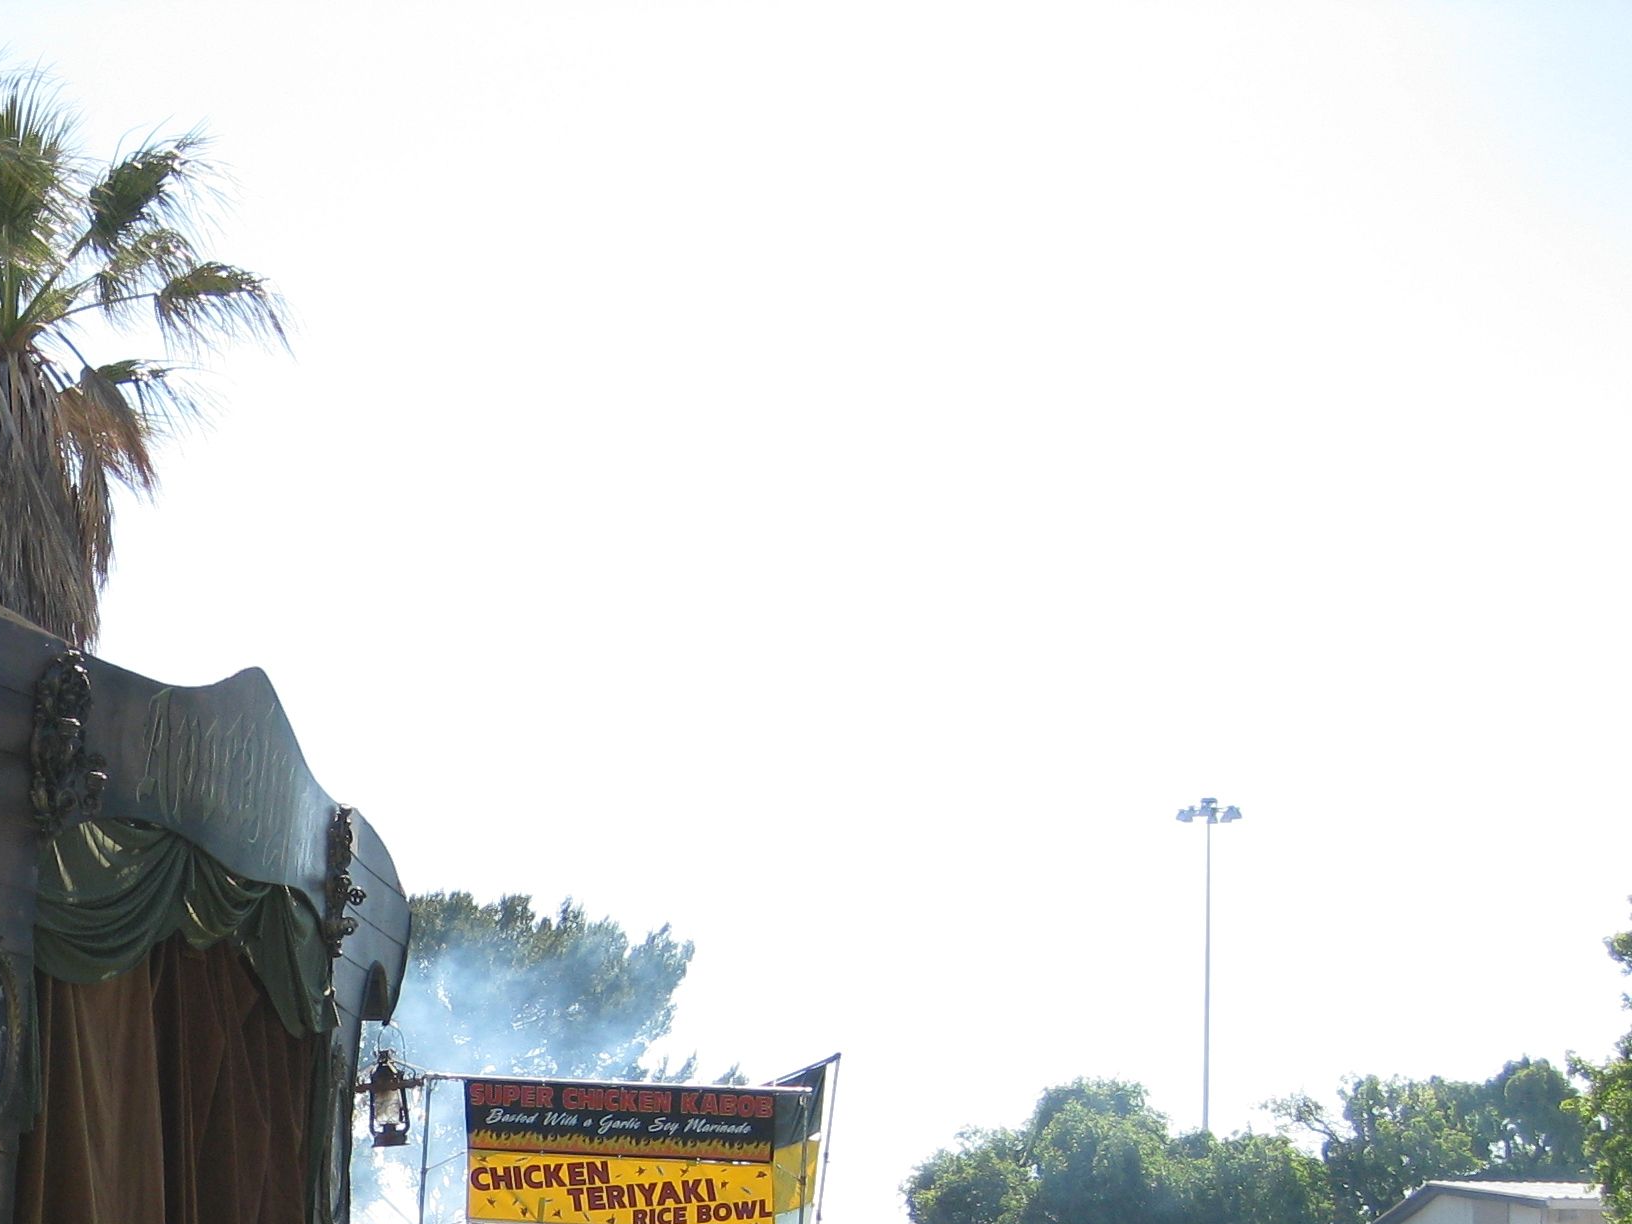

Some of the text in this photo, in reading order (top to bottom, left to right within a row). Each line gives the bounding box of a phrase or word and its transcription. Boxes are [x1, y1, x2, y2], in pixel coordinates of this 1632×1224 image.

[469, 1083, 773, 1118] SUPER CHICKEN KABOB
[485, 1108, 751, 1134] Basted With a Garlic Soy Marinade
[470, 1161, 610, 1191] CHICKEN
[567, 1178, 717, 1212] TERIYAKI
[697, 1199, 772, 1224] BOWL
